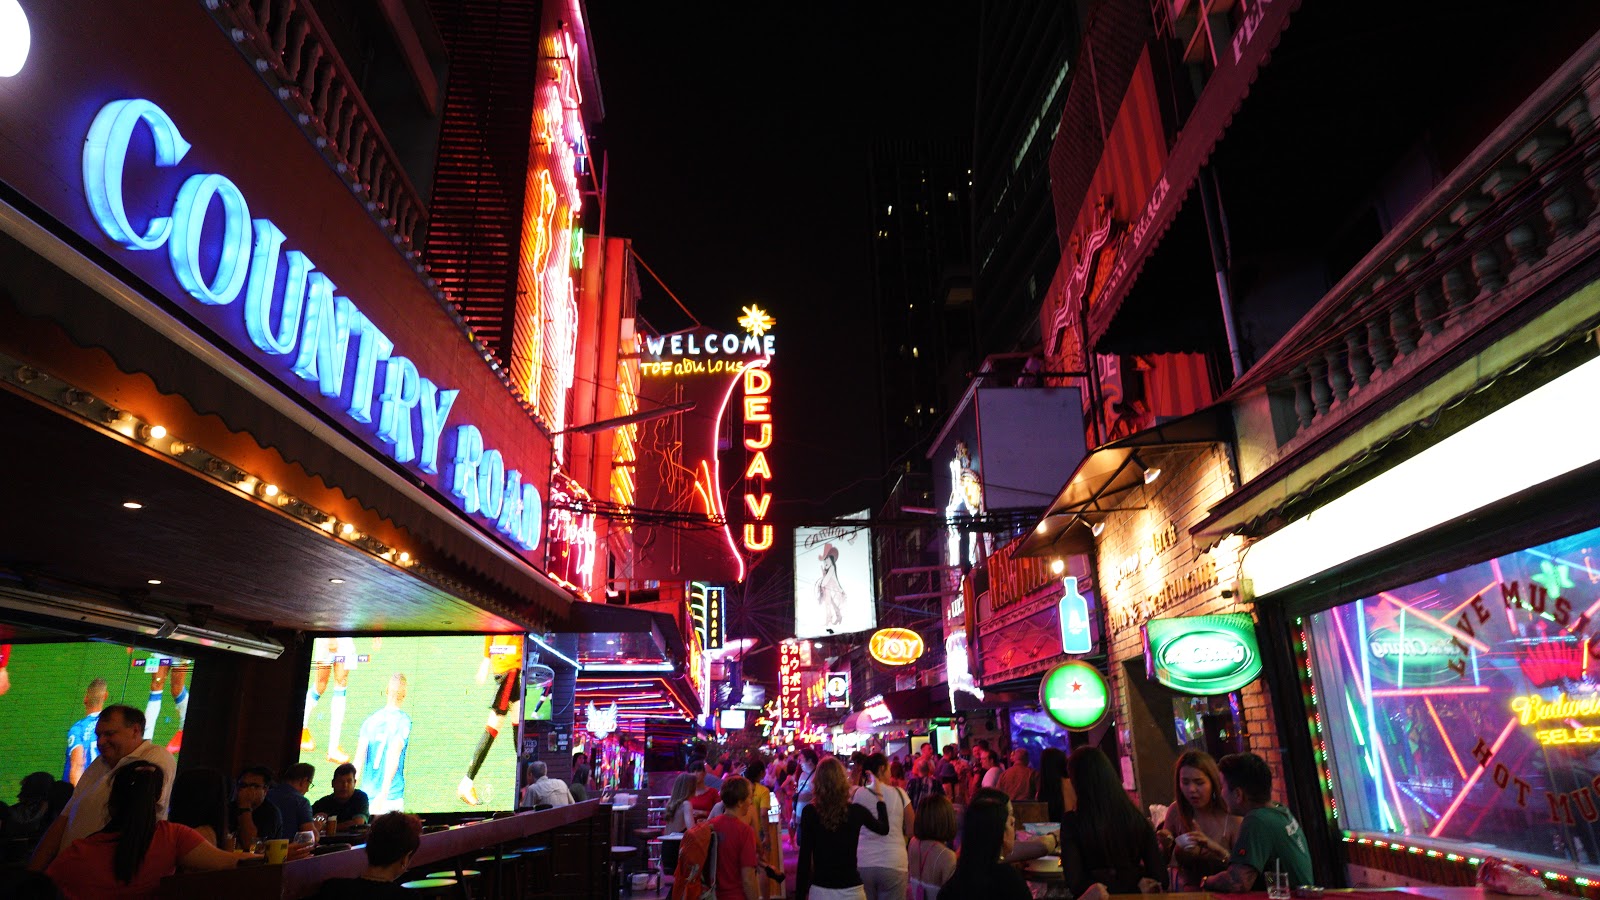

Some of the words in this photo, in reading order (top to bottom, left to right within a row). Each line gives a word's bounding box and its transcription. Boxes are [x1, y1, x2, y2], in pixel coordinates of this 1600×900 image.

[82, 98, 460, 475] COUNTRY
[451, 424, 543, 552] ROAD
[646, 333, 776, 356] WELCOME
[743, 368, 773, 480] DEJA
[743, 493, 774, 551] VU
[876, 635, 919, 659] TOY
[1448, 594, 1491, 677] LIVE
[1511, 691, 1600, 726] Budwei
[1471, 737, 1531, 809] HOT
